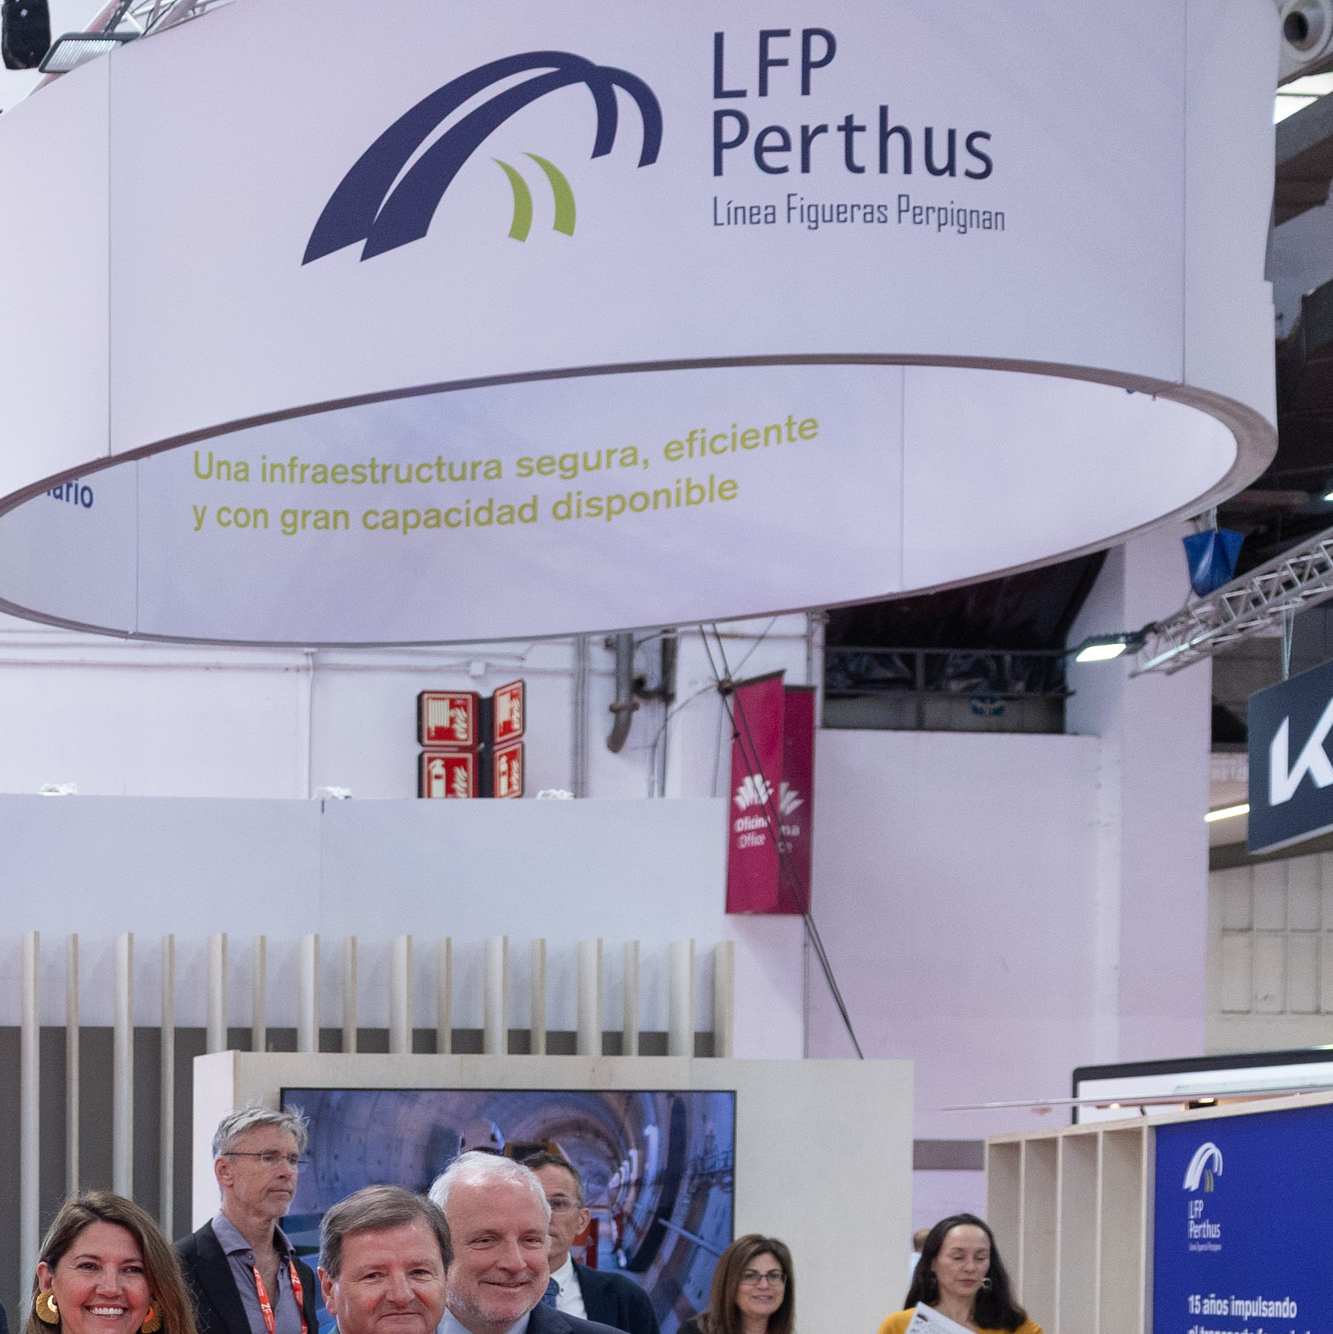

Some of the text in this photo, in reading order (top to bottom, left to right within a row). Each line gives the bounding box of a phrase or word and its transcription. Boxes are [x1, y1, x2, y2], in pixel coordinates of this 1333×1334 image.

[713, 27, 838, 99] LFP
[713, 105, 993, 180] Perthus
[713, 193, 1005, 234] Línea Figueras Perpignan
[193, 414, 820, 485] Una infraestructura segura, eficiente
[47, 478, 94, 509] ario
[192, 473, 740, 537] y con gran capacidad disponible
[1188, 1200, 1205, 1219] LFP
[1188, 1217, 1222, 1239] Perthus
[1188, 1293, 1298, 1321] 15 años impulsando
